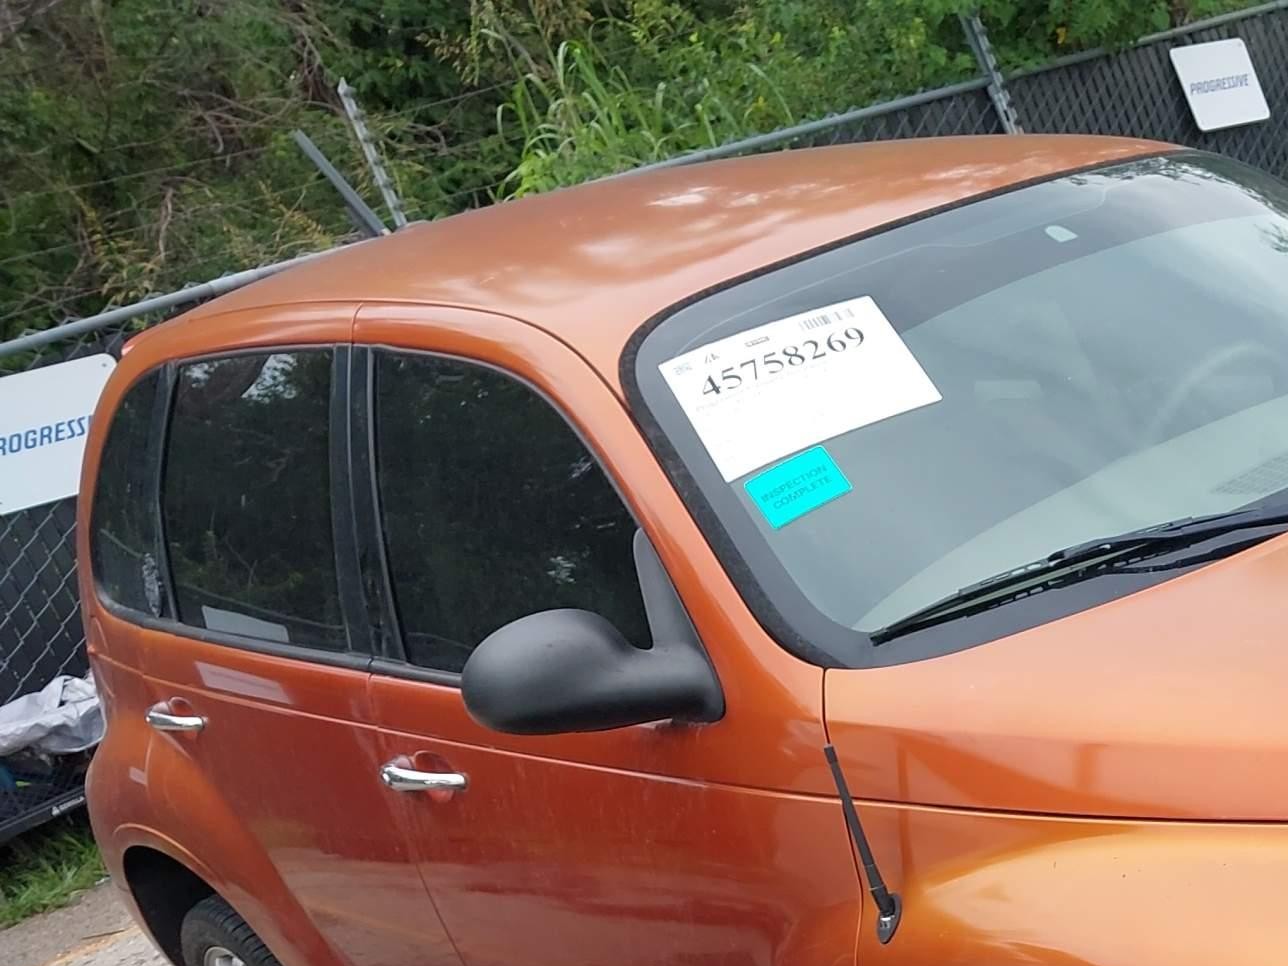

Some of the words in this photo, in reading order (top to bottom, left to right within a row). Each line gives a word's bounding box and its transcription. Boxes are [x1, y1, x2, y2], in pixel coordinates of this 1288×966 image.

[1190, 74, 1248, 95] PROGRESSIVE
[702, 327, 865, 395] 45758269
[760, 463, 828, 504] INSPECTION
[772, 475, 833, 510] COMPLETE
